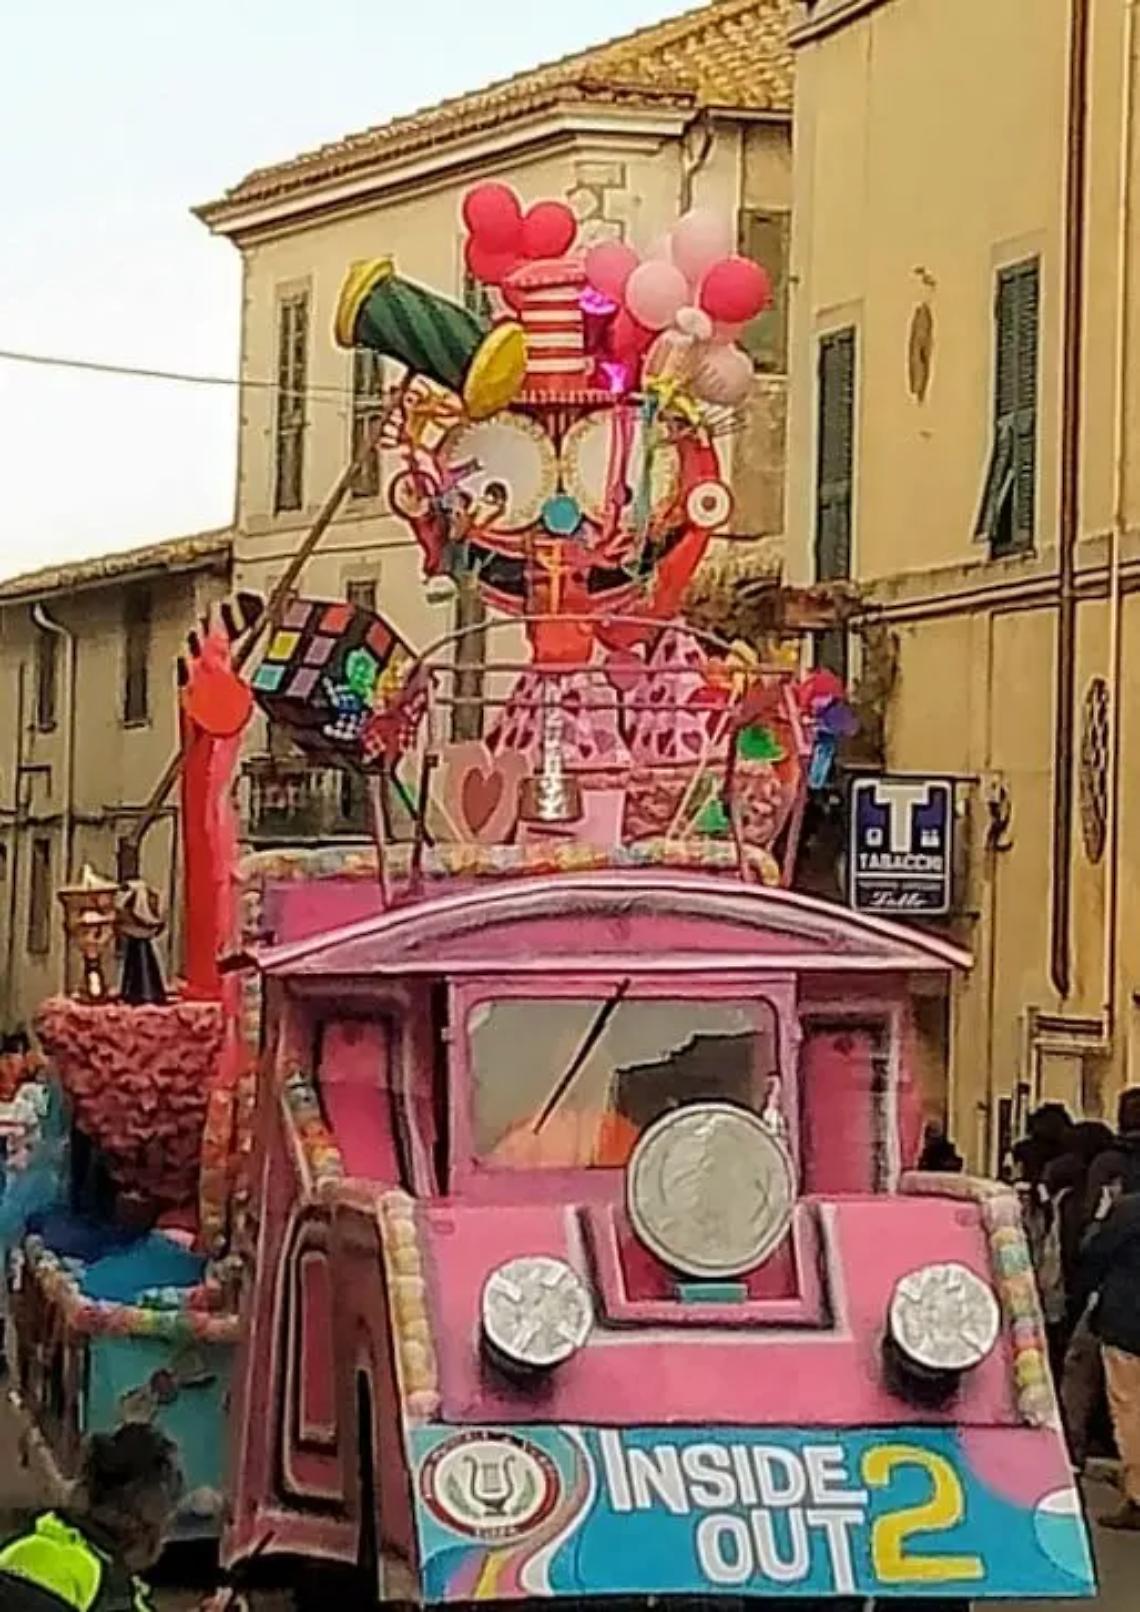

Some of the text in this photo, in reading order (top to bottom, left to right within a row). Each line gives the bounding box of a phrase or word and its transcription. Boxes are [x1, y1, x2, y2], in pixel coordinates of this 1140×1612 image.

[875, 784, 929, 852] T
[598, 1425, 868, 1514] INSIDE
[697, 1443, 985, 1594] OUT 2
